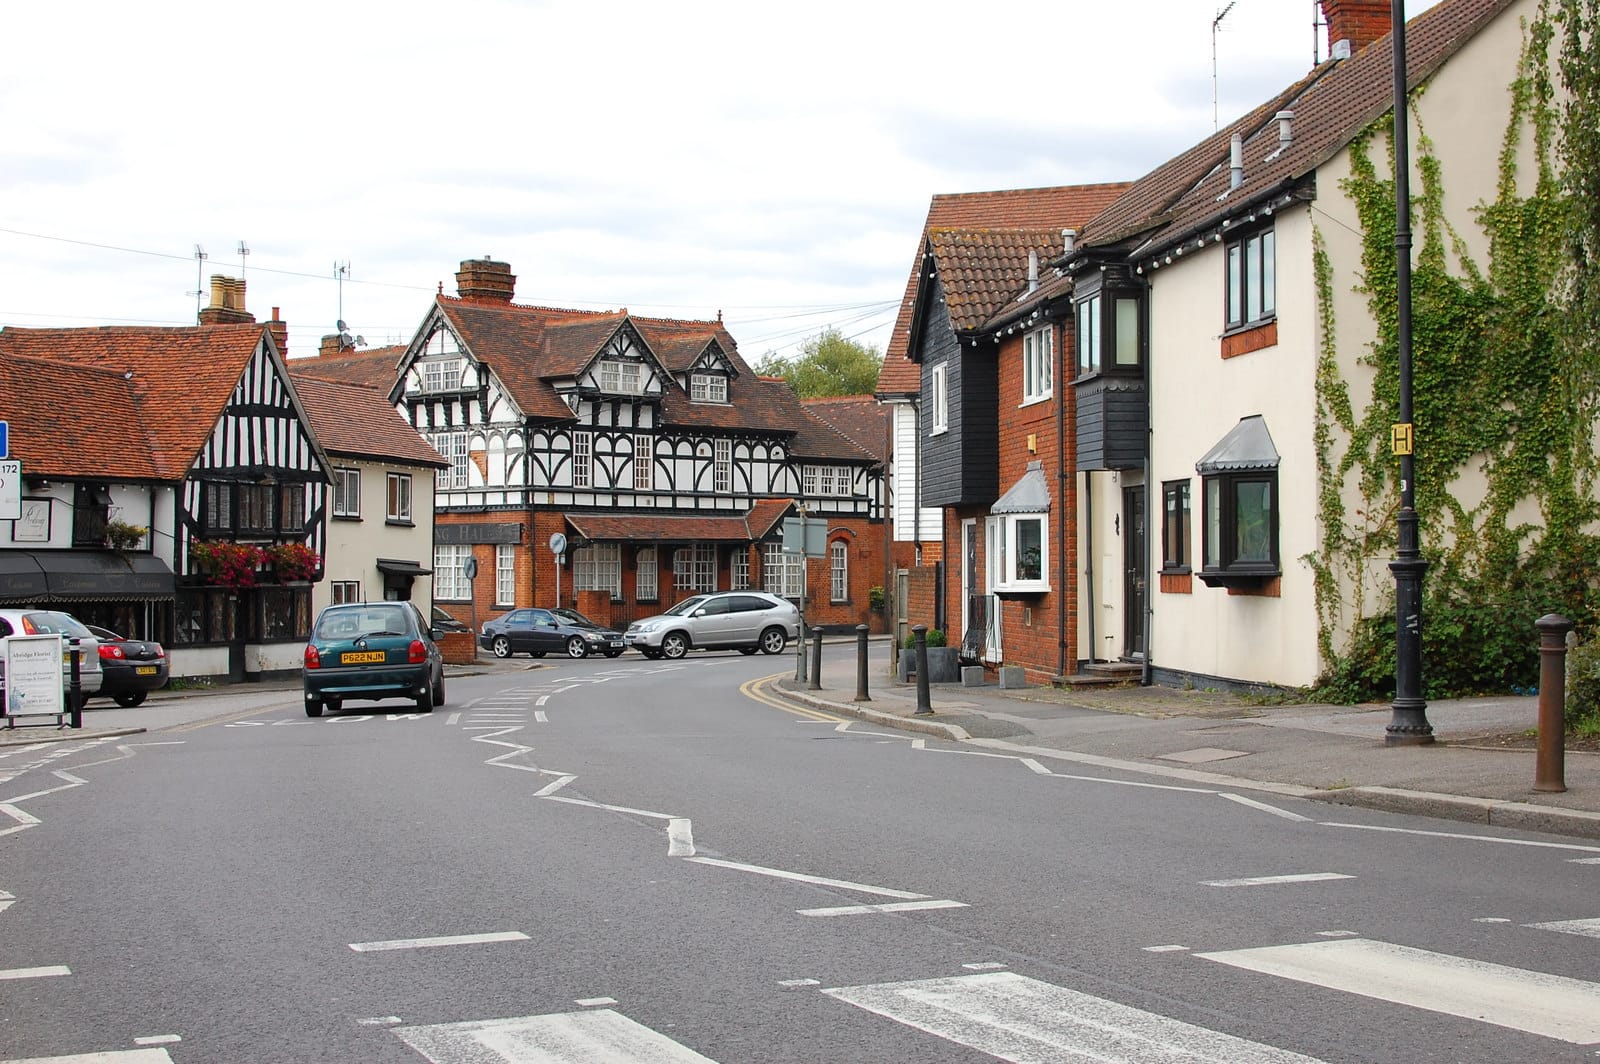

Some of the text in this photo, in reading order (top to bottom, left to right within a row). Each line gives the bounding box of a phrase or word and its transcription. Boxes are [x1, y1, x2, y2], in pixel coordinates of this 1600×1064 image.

[1394, 427, 1408, 451] H
[2, 464, 18, 474] 172
[343, 652, 384, 662] P622 NJN
